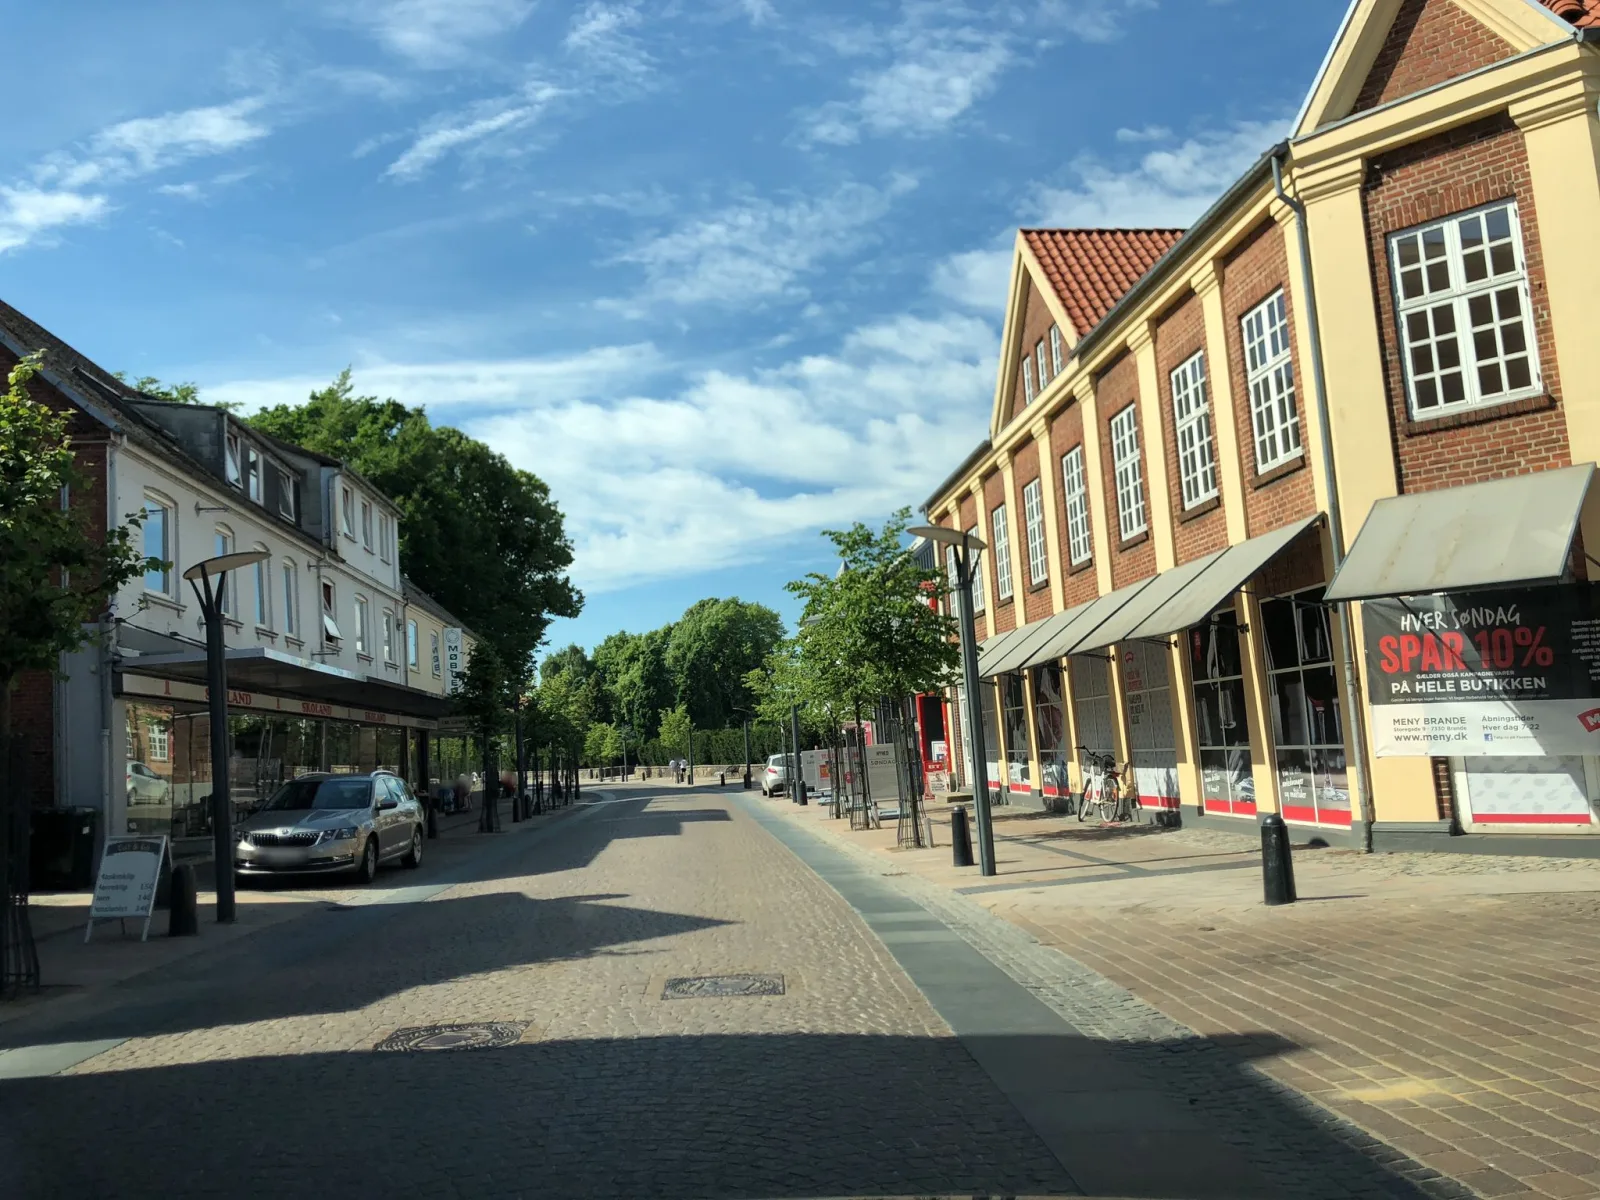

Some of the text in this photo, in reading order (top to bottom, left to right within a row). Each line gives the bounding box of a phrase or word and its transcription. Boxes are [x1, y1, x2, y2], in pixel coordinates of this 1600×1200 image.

[1400, 604, 1521, 632] HVER SØNDAG
[1379, 626, 1554, 674] SPAR 10%
[1391, 677, 1546, 694] PÅ HELE BUTIKKEN
[1393, 716, 1467, 726] MENY BRANDE
[1503, 724, 1518, 732] dag
[1394, 732, 1468, 742] www.meny.dk
